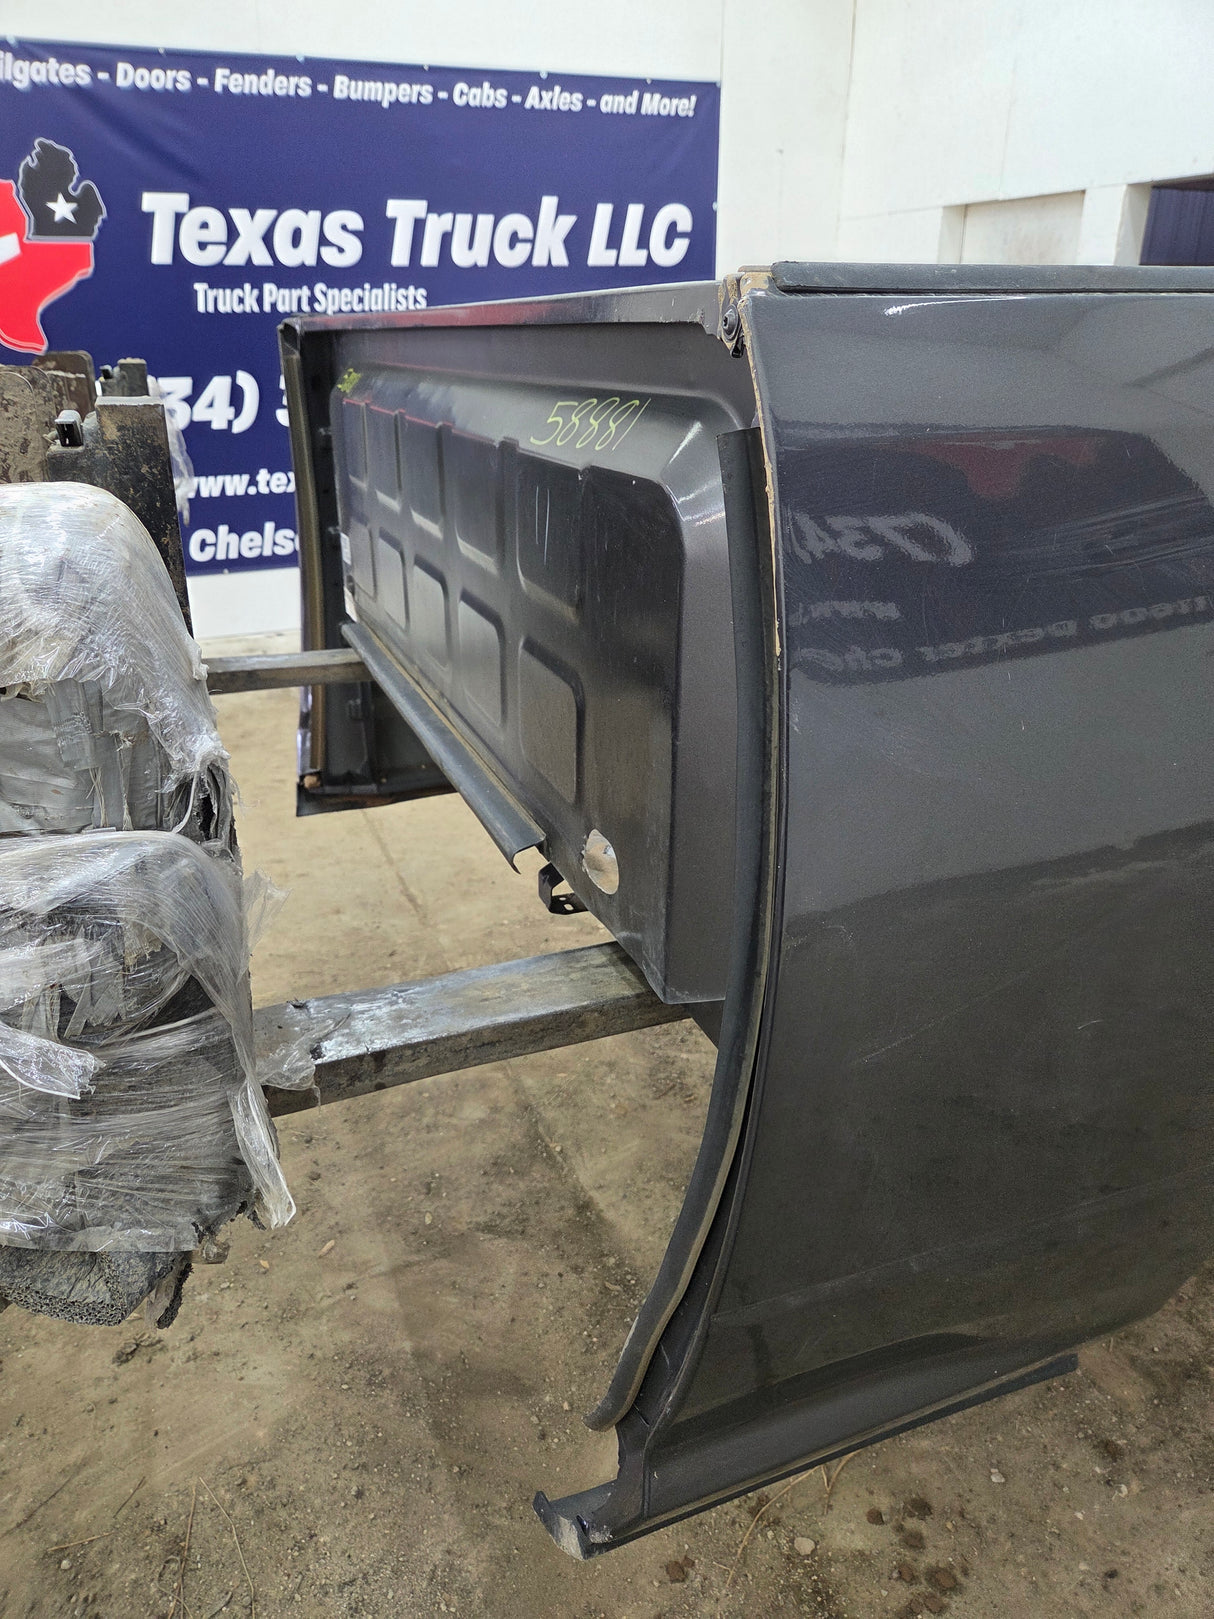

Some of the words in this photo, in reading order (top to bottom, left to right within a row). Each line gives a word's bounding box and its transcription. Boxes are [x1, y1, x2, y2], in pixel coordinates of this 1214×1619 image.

[115, 61, 192, 91] Doors
[214, 67, 313, 97] Fenders
[333, 74, 434, 109] Bumpers
[452, 81, 508, 108] Cabs
[523, 84, 584, 112] Axles
[599, 89, 639, 115] and
[640, 92, 698, 117] More!
[141, 191, 365, 268] Texas
[385, 195, 578, 268] Truck
[586, 202, 694, 268] LLC
[193, 282, 260, 314] Truck
[262, 282, 310, 313] Part
[312, 282, 428, 315] Specialists
[188, 521, 300, 563] Chels
